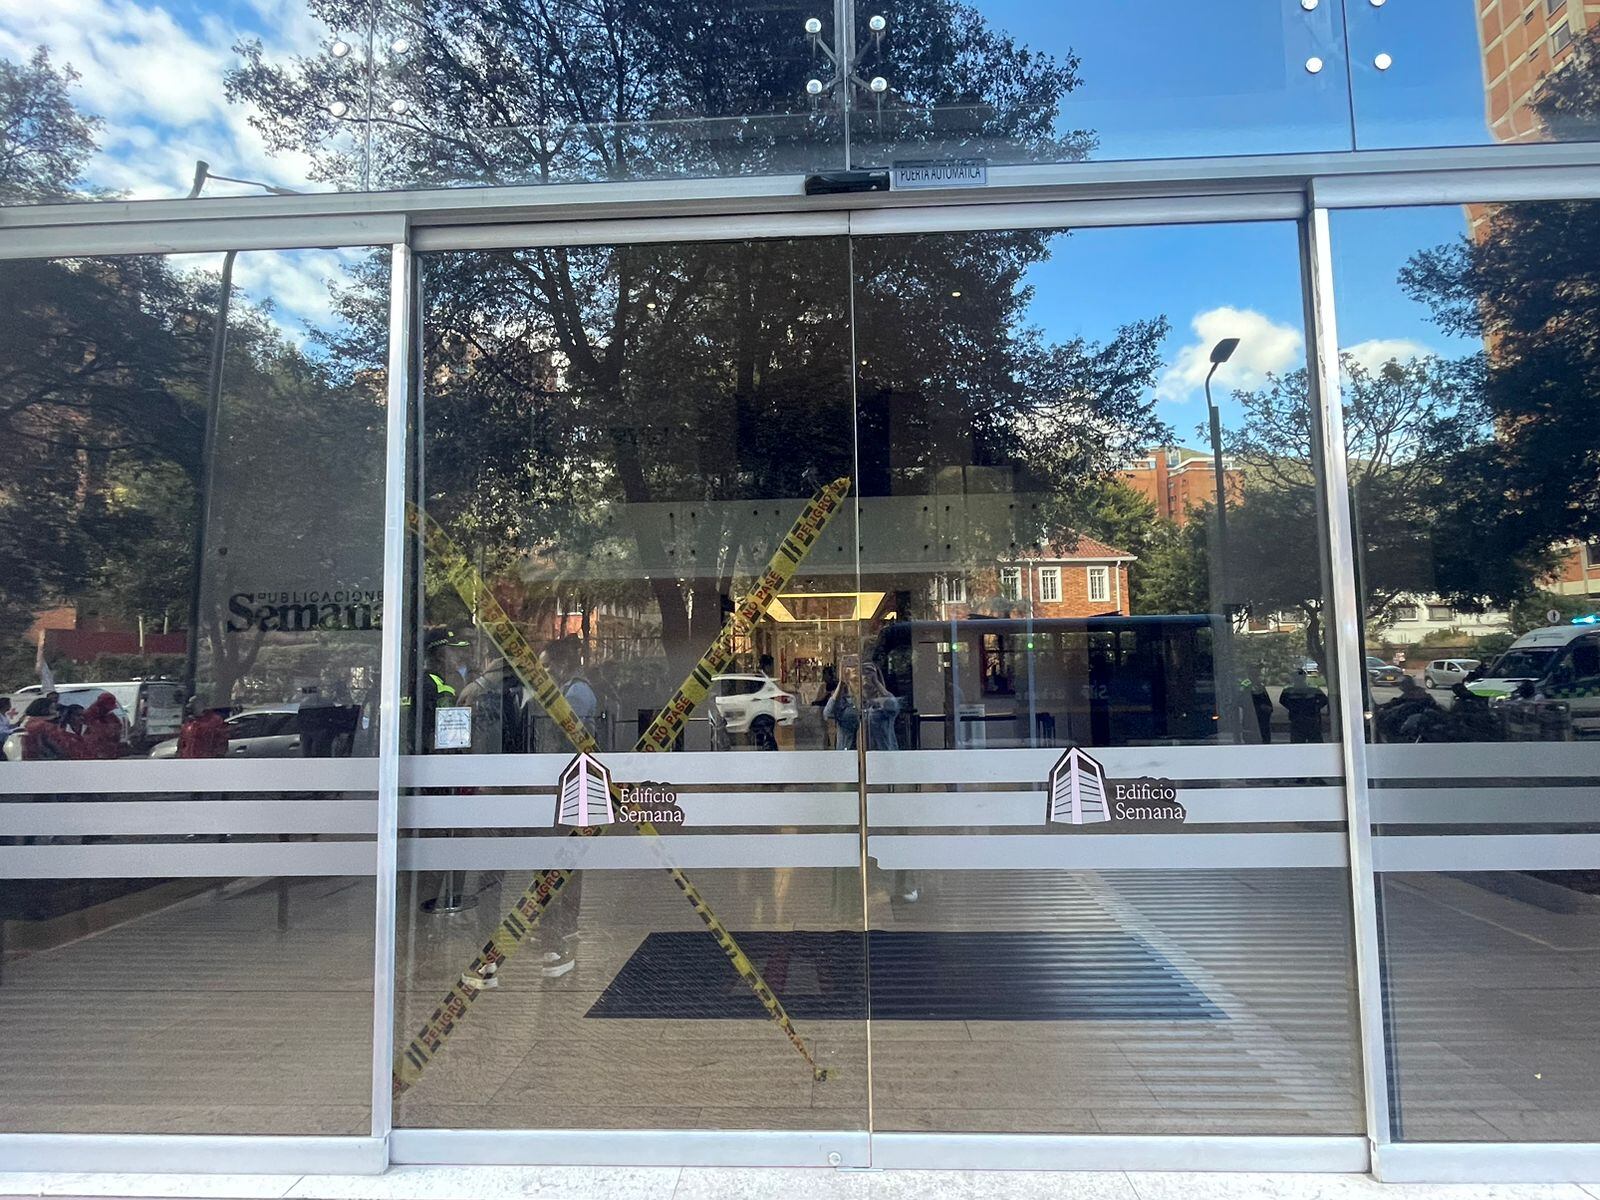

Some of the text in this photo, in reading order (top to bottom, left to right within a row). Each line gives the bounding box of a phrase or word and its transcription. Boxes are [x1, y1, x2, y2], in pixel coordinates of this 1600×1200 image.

[796, 495, 832, 542] PELIGRO
[257, 591, 383, 603] PUBLICACIONE
[742, 601, 758, 619] NO
[756, 571, 779, 600] PASE
[652, 696, 690, 744] NO PASE
[620, 787, 676, 804] Edificio
[1115, 783, 1175, 801] Edificio
[619, 805, 683, 823] Semana
[1115, 802, 1184, 820] Semana
[423, 997, 464, 1048] PELIGRO
